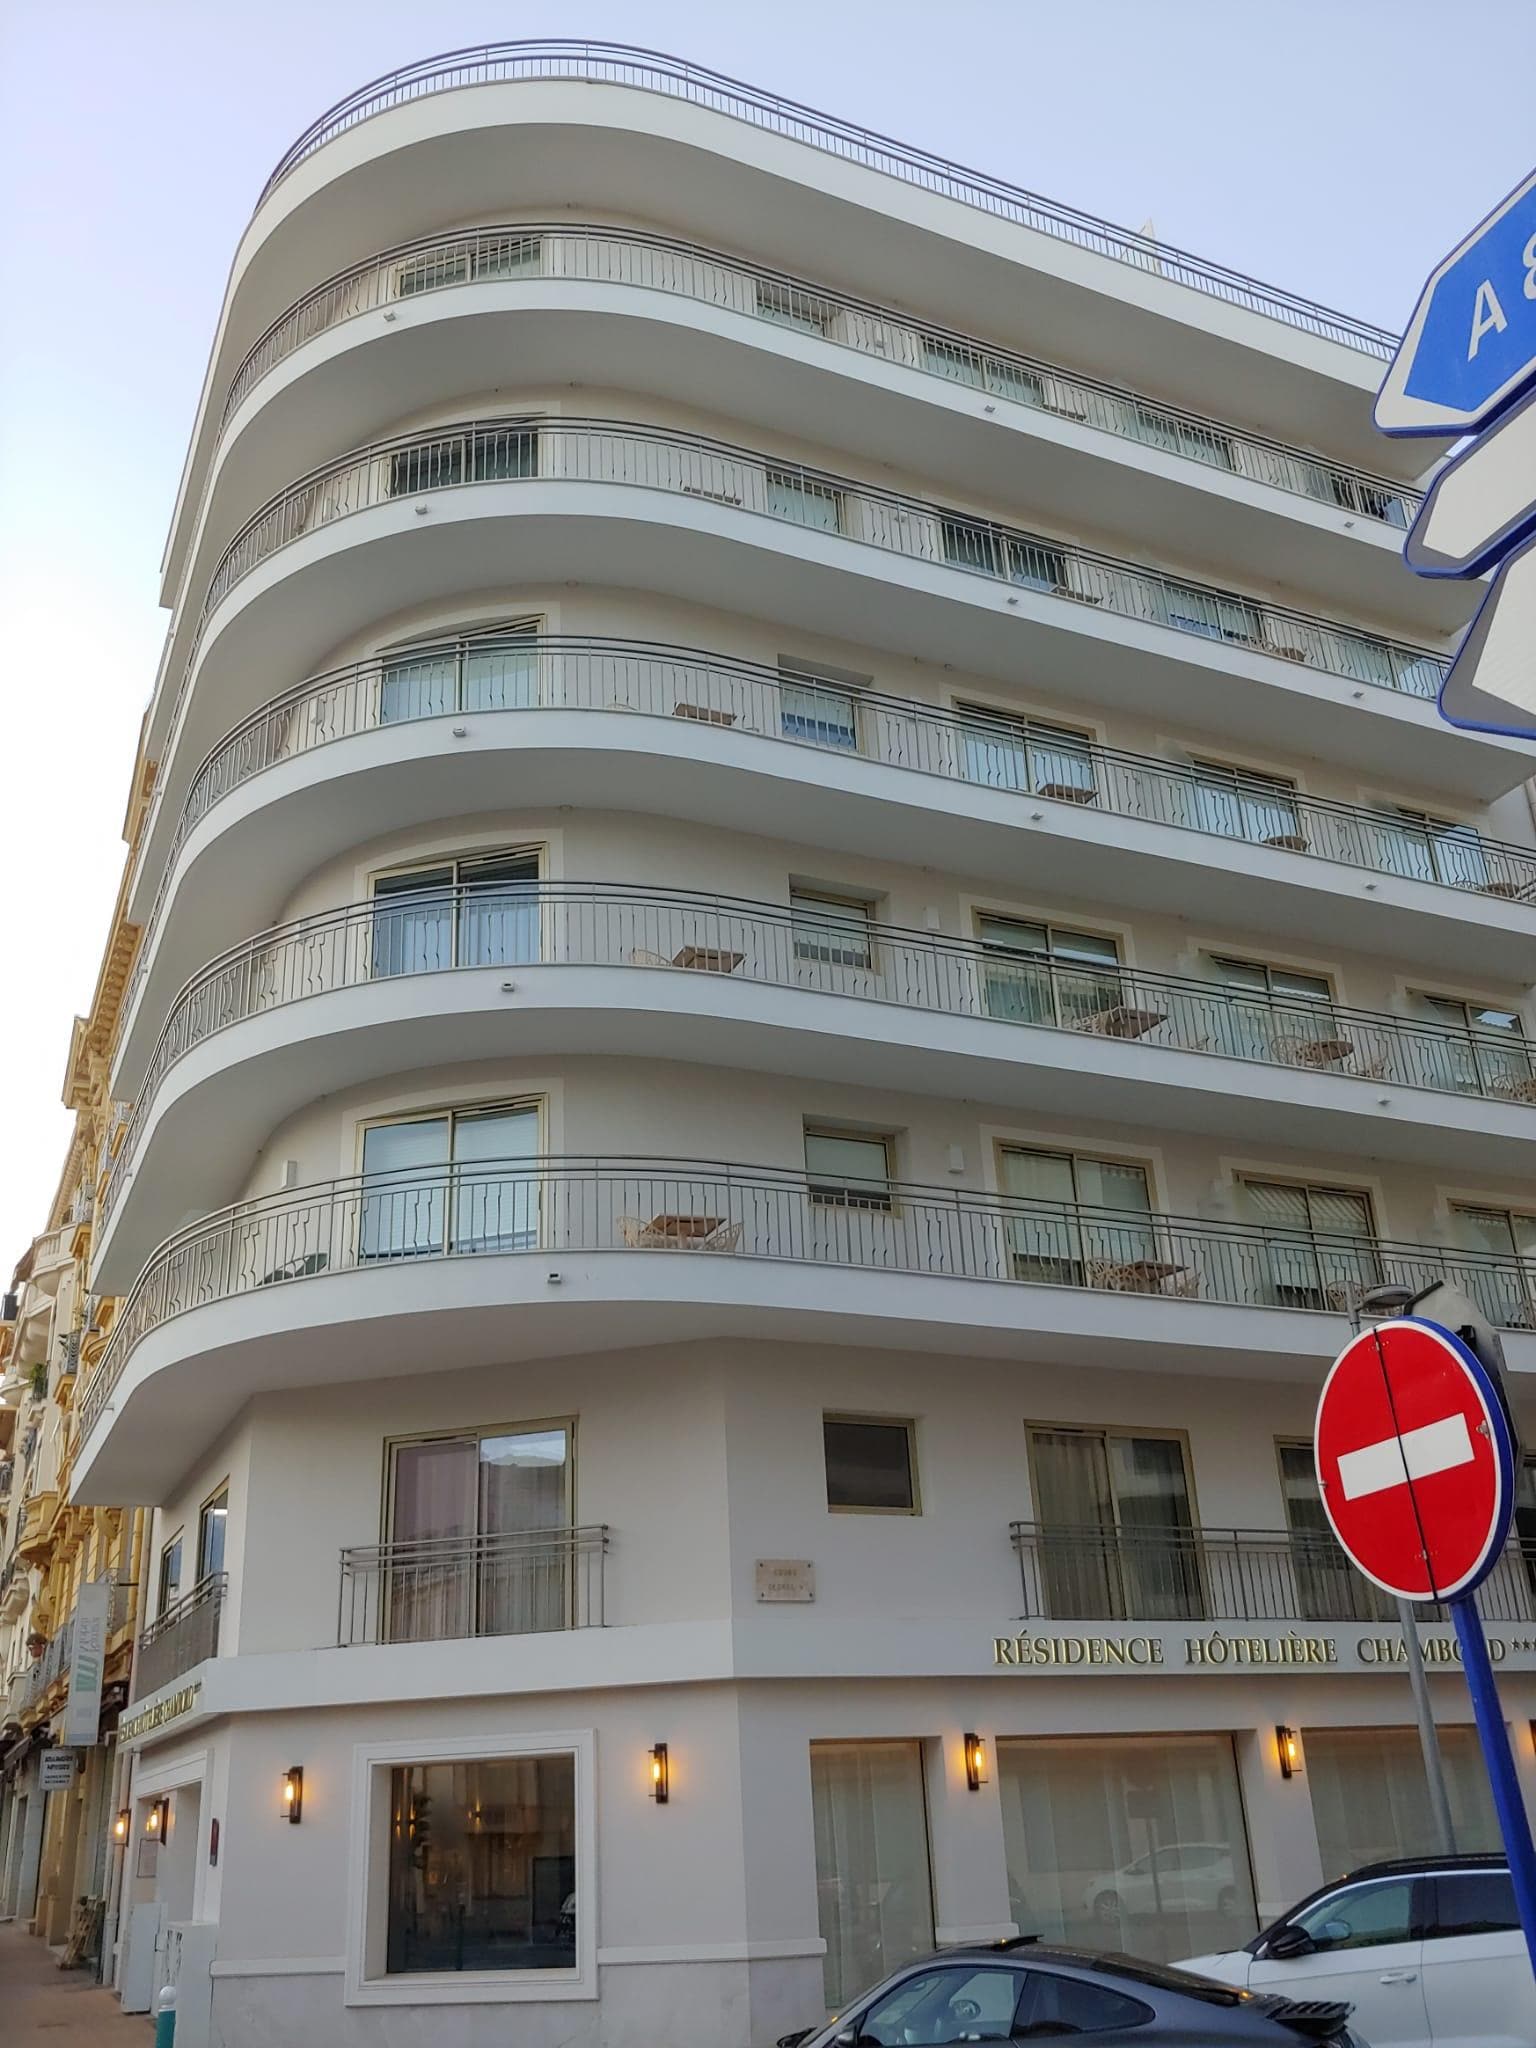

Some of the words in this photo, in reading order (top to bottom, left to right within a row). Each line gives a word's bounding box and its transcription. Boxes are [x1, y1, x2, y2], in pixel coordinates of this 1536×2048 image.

[1467, 279, 1508, 363] A
[993, 1629, 1165, 1665] RÉSIDENCE
[1184, 1630, 1338, 1664] HÔTELIÈRE
[1356, 1637, 1507, 1663] CHAMBD
